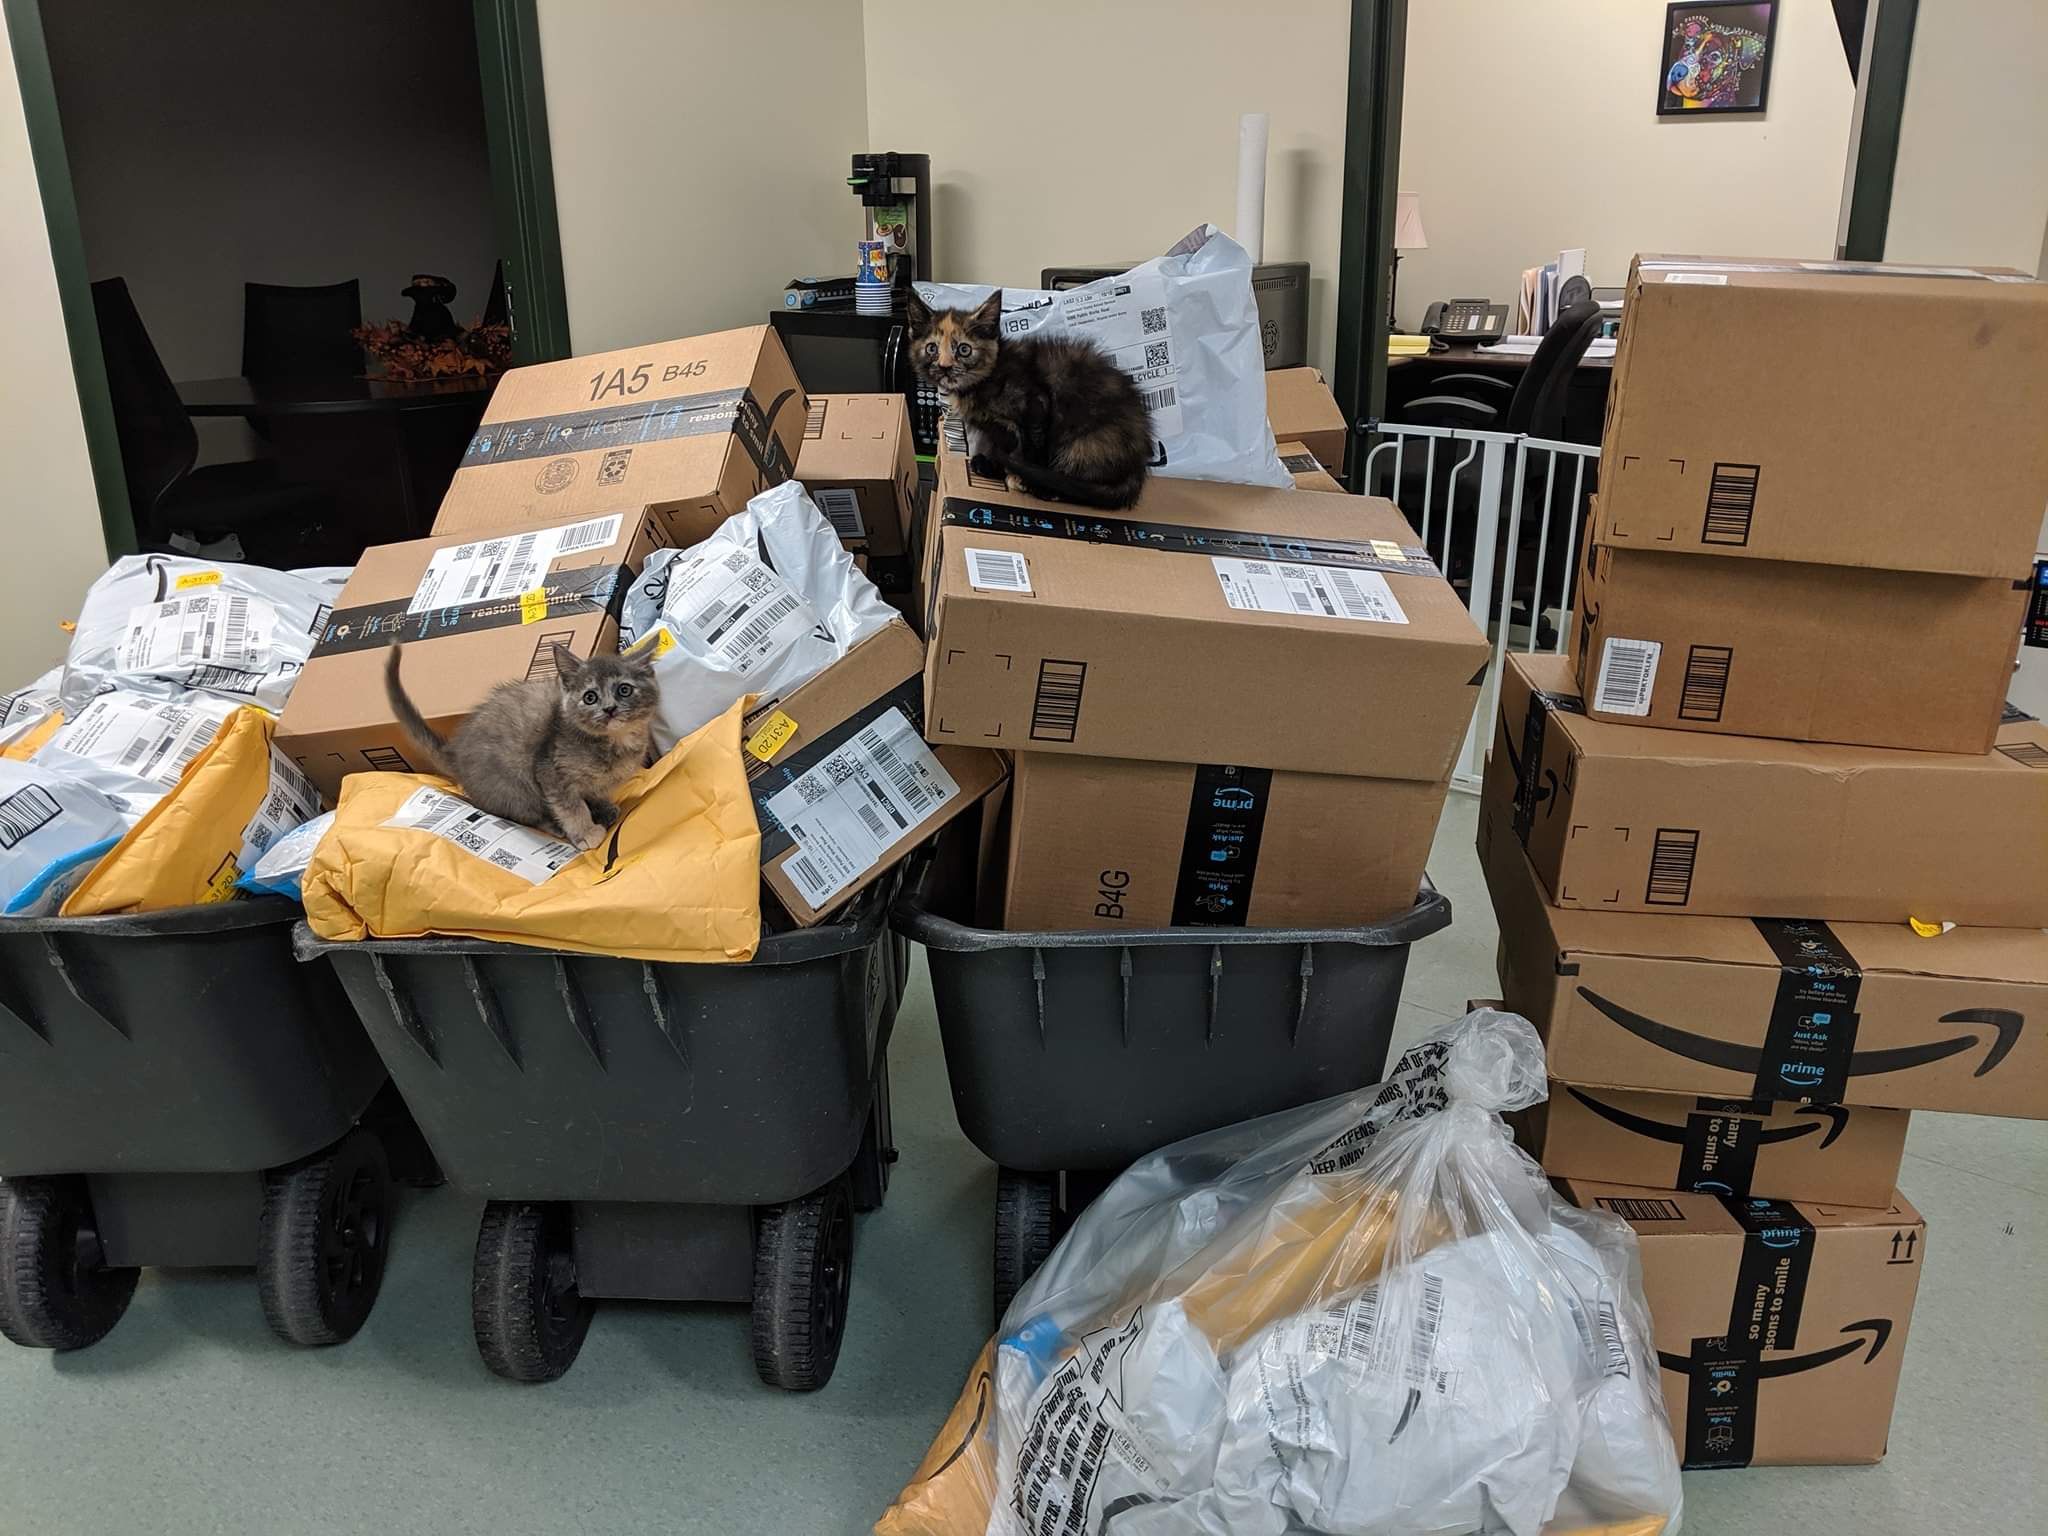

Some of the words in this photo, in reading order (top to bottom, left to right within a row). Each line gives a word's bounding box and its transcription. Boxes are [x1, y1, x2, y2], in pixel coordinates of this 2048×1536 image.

[588, 362, 655, 402] 1A5
[662, 359, 709, 382] B45
[1137, 370, 1161, 383] CYCLE
[688, 409, 741, 424] reasons
[471, 602, 522, 619] reasons
[1213, 797, 1254, 811] prime
[1094, 869, 1131, 920] B4G
[1813, 981, 1836, 991] Style
[1793, 1031, 1811, 1041] Just
[1813, 1033, 1828, 1042] Ask
[1780, 1062, 1825, 1076] prime
[1708, 1117, 1723, 1133] to
[1702, 1135, 1719, 1172] smile
[1761, 1228, 1801, 1240] prime
[1774, 1256, 1791, 1296] smile
[1751, 1284, 1771, 1320] many
[1769, 1296, 1784, 1312] to
[1748, 1321, 1761, 1341] so
